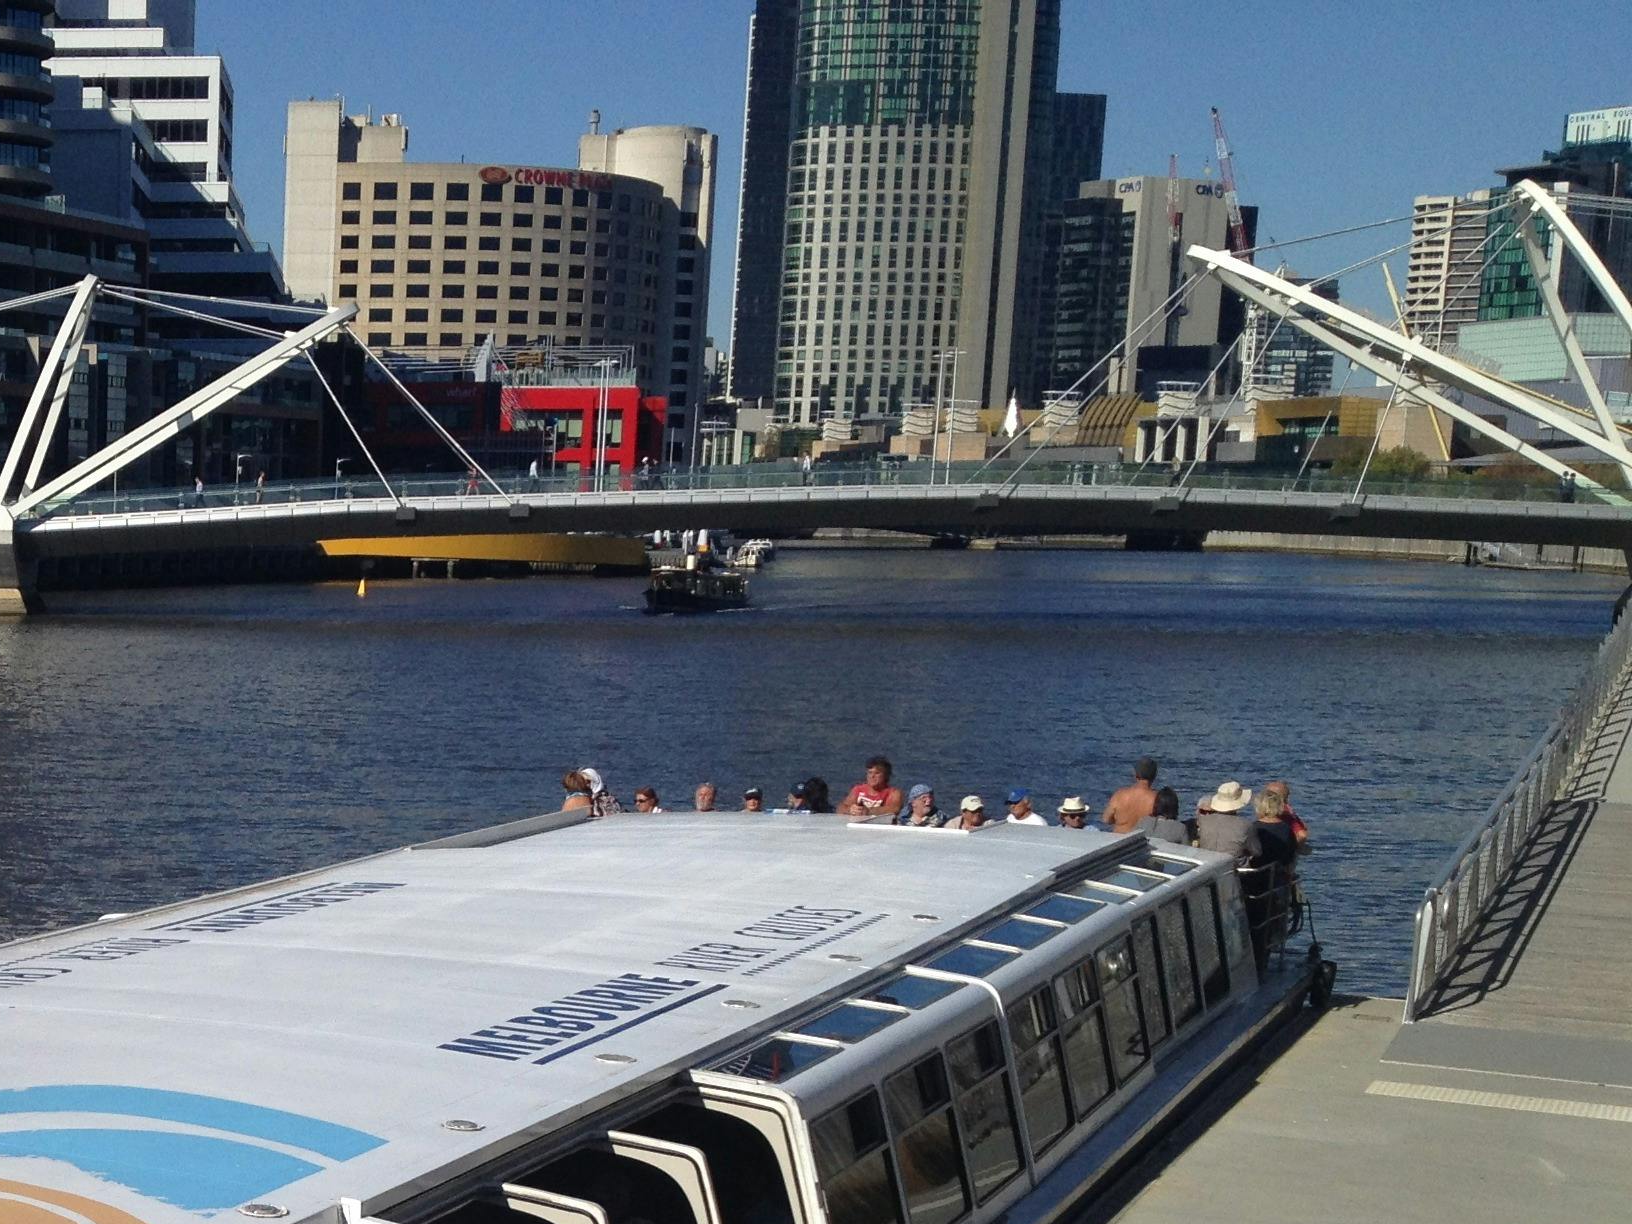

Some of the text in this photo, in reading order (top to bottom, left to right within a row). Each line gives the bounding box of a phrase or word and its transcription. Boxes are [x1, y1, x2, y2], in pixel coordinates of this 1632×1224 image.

[514, 168, 573, 188] CROWNE
[168, 882, 407, 933] MELBOURNE
[58, 937, 190, 961] RIVER
[436, 904, 864, 1061] MELBOURNE RIVER CRUISES
